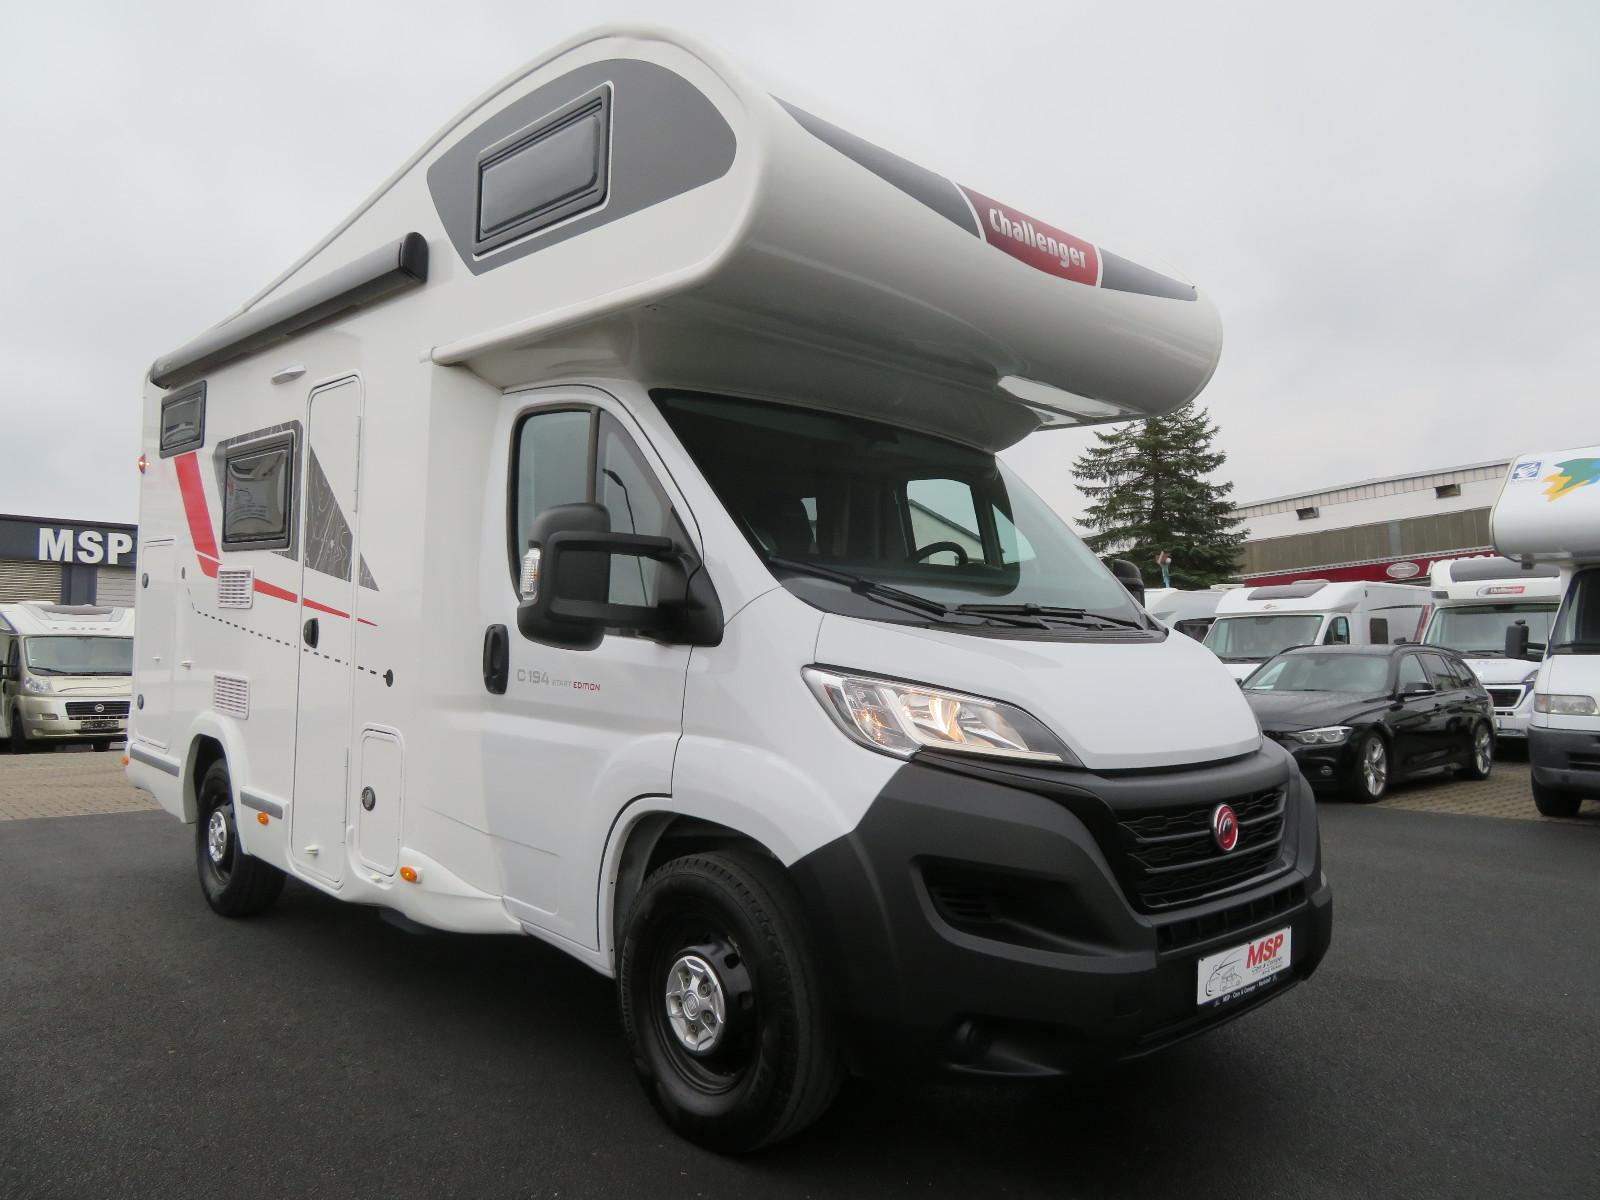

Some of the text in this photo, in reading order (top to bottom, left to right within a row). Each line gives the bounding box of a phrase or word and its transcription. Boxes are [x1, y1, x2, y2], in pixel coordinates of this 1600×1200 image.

[989, 207, 1087, 269] Challenger
[38, 527, 133, 565] MSP
[517, 668, 526, 682] C
[529, 670, 549, 686] 194
[573, 681, 601, 691] EDITION
[1246, 933, 1284, 969] MSP
